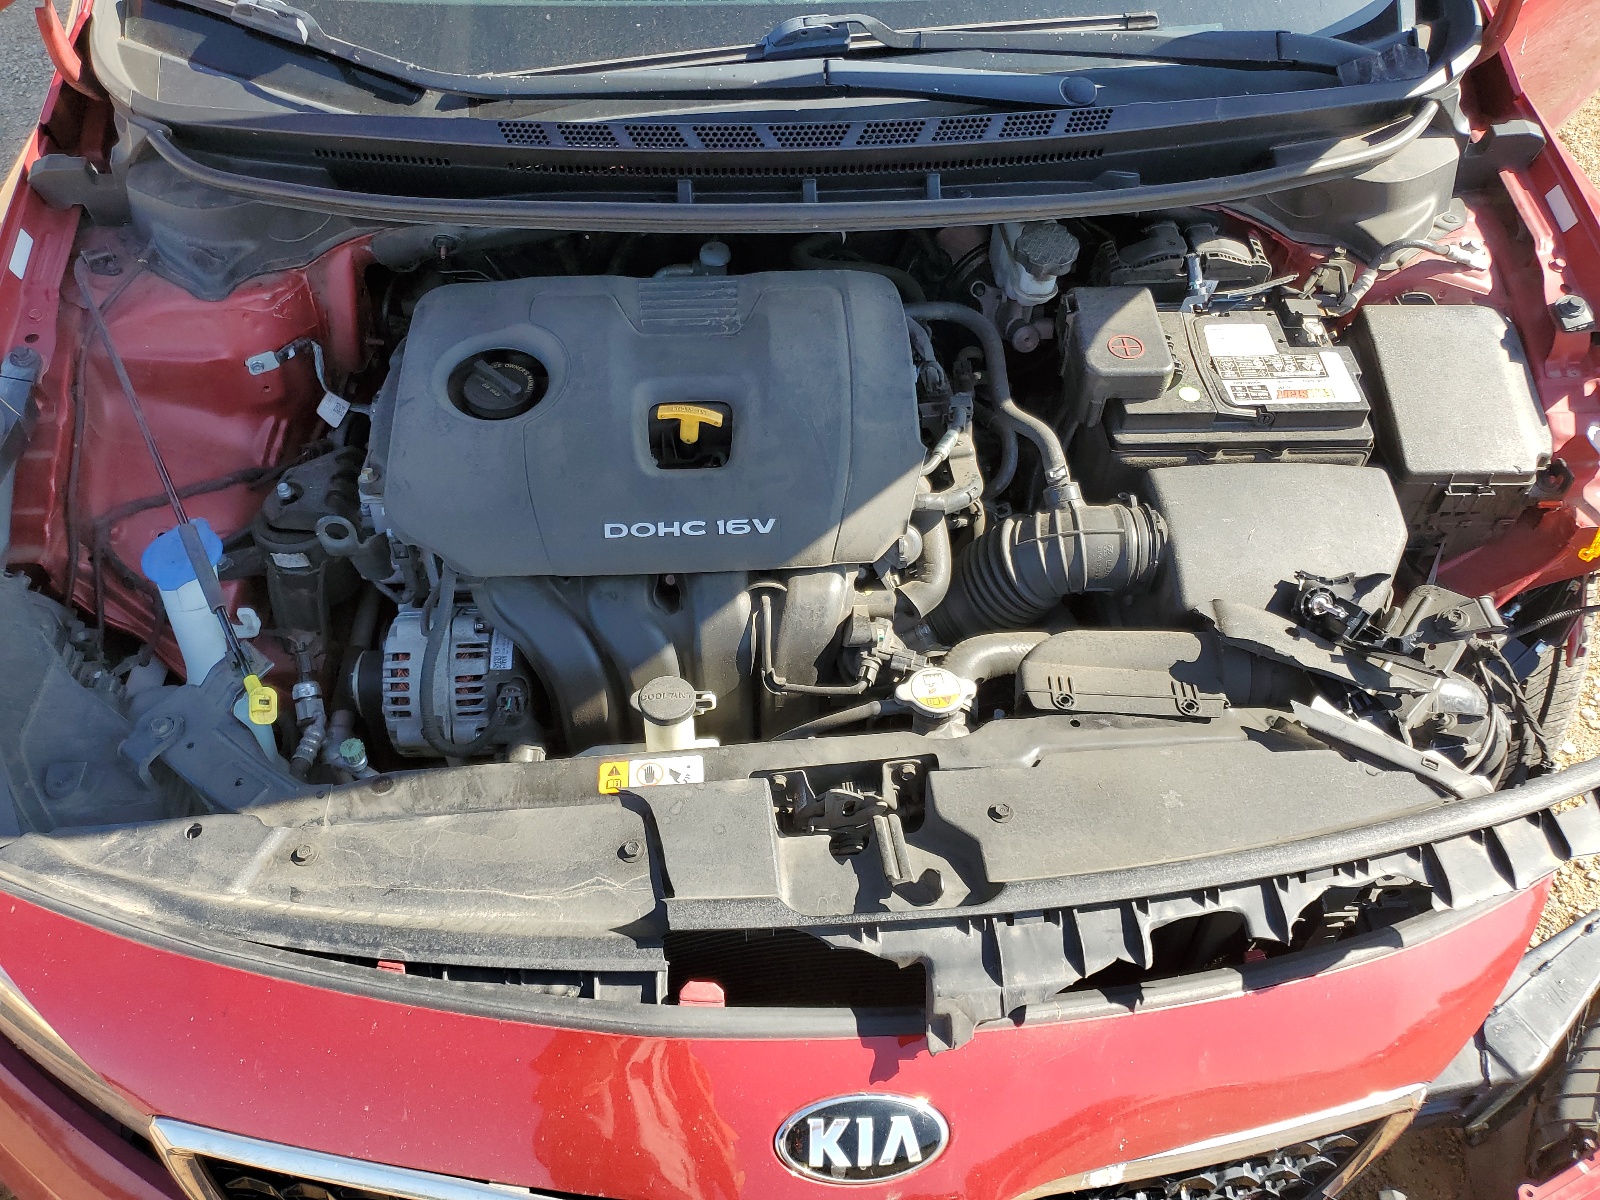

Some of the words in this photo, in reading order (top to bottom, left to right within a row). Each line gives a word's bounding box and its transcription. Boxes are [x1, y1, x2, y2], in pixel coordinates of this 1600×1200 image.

[603, 520, 708, 540] DOHC
[715, 517, 777, 536] 16V
[640, 691, 693, 702] COOLANT
[806, 1115, 923, 1169] KIA
